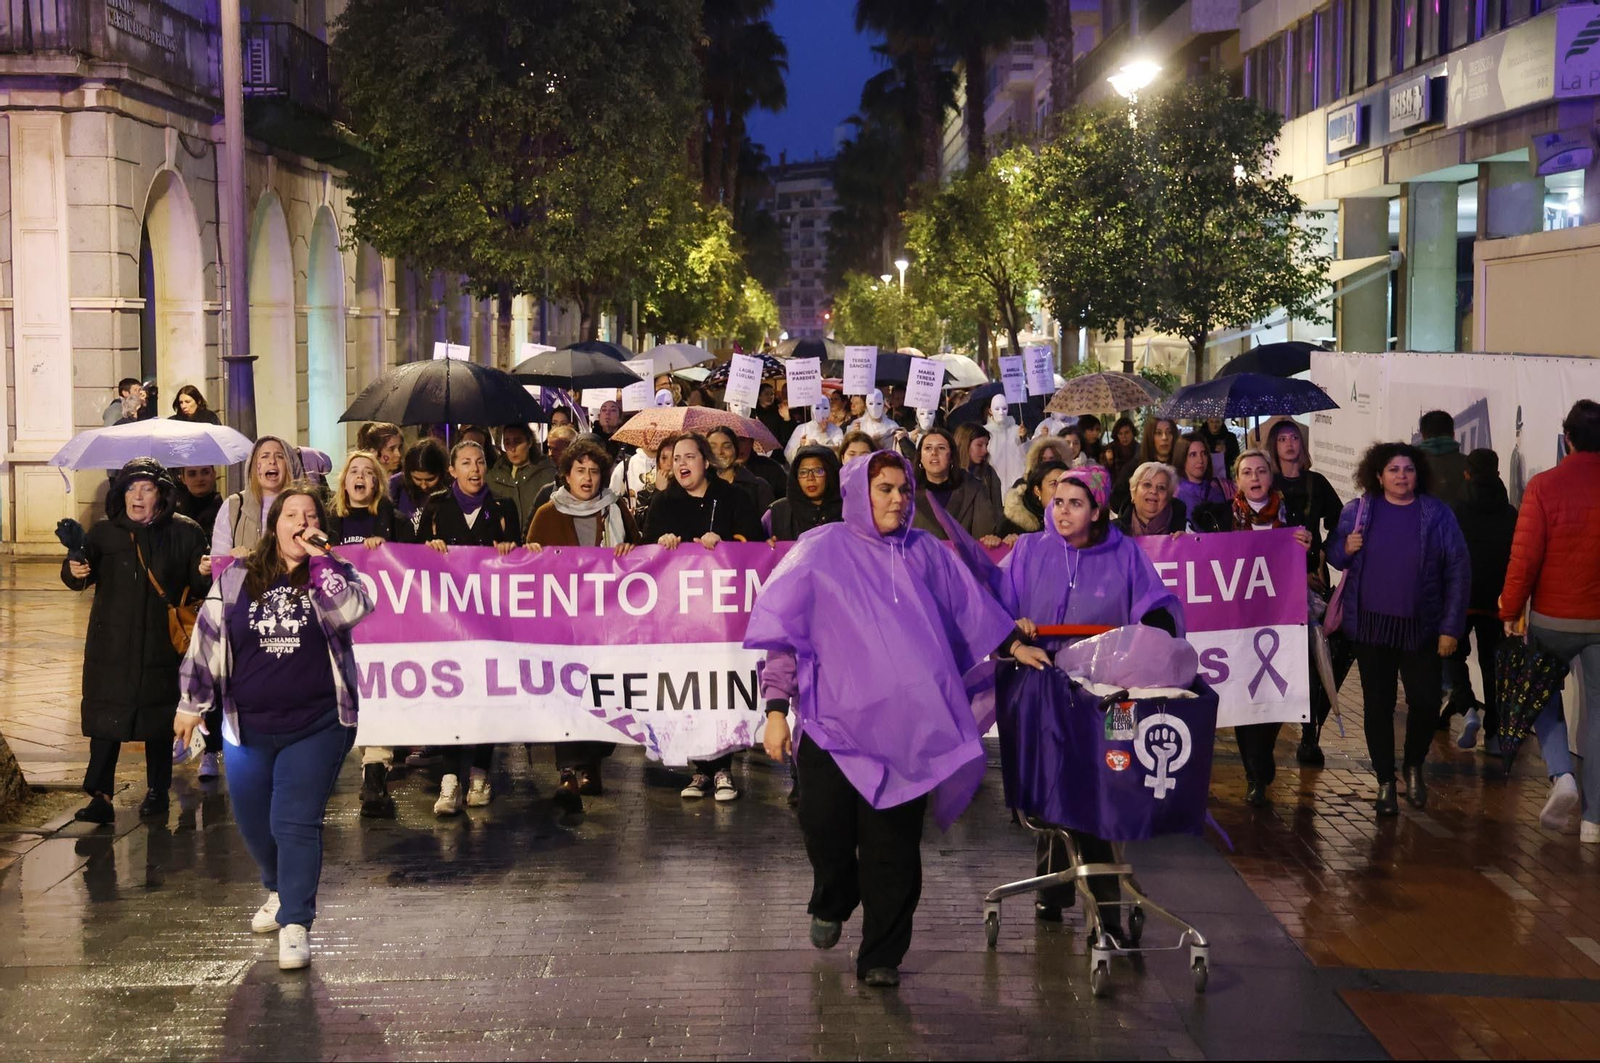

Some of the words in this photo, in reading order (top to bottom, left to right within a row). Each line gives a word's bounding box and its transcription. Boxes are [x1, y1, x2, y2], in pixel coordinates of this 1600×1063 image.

[1561, 75, 1581, 90] La
[916, 374, 936, 382] TERESA
[344, 536, 366, 544] LIBER
